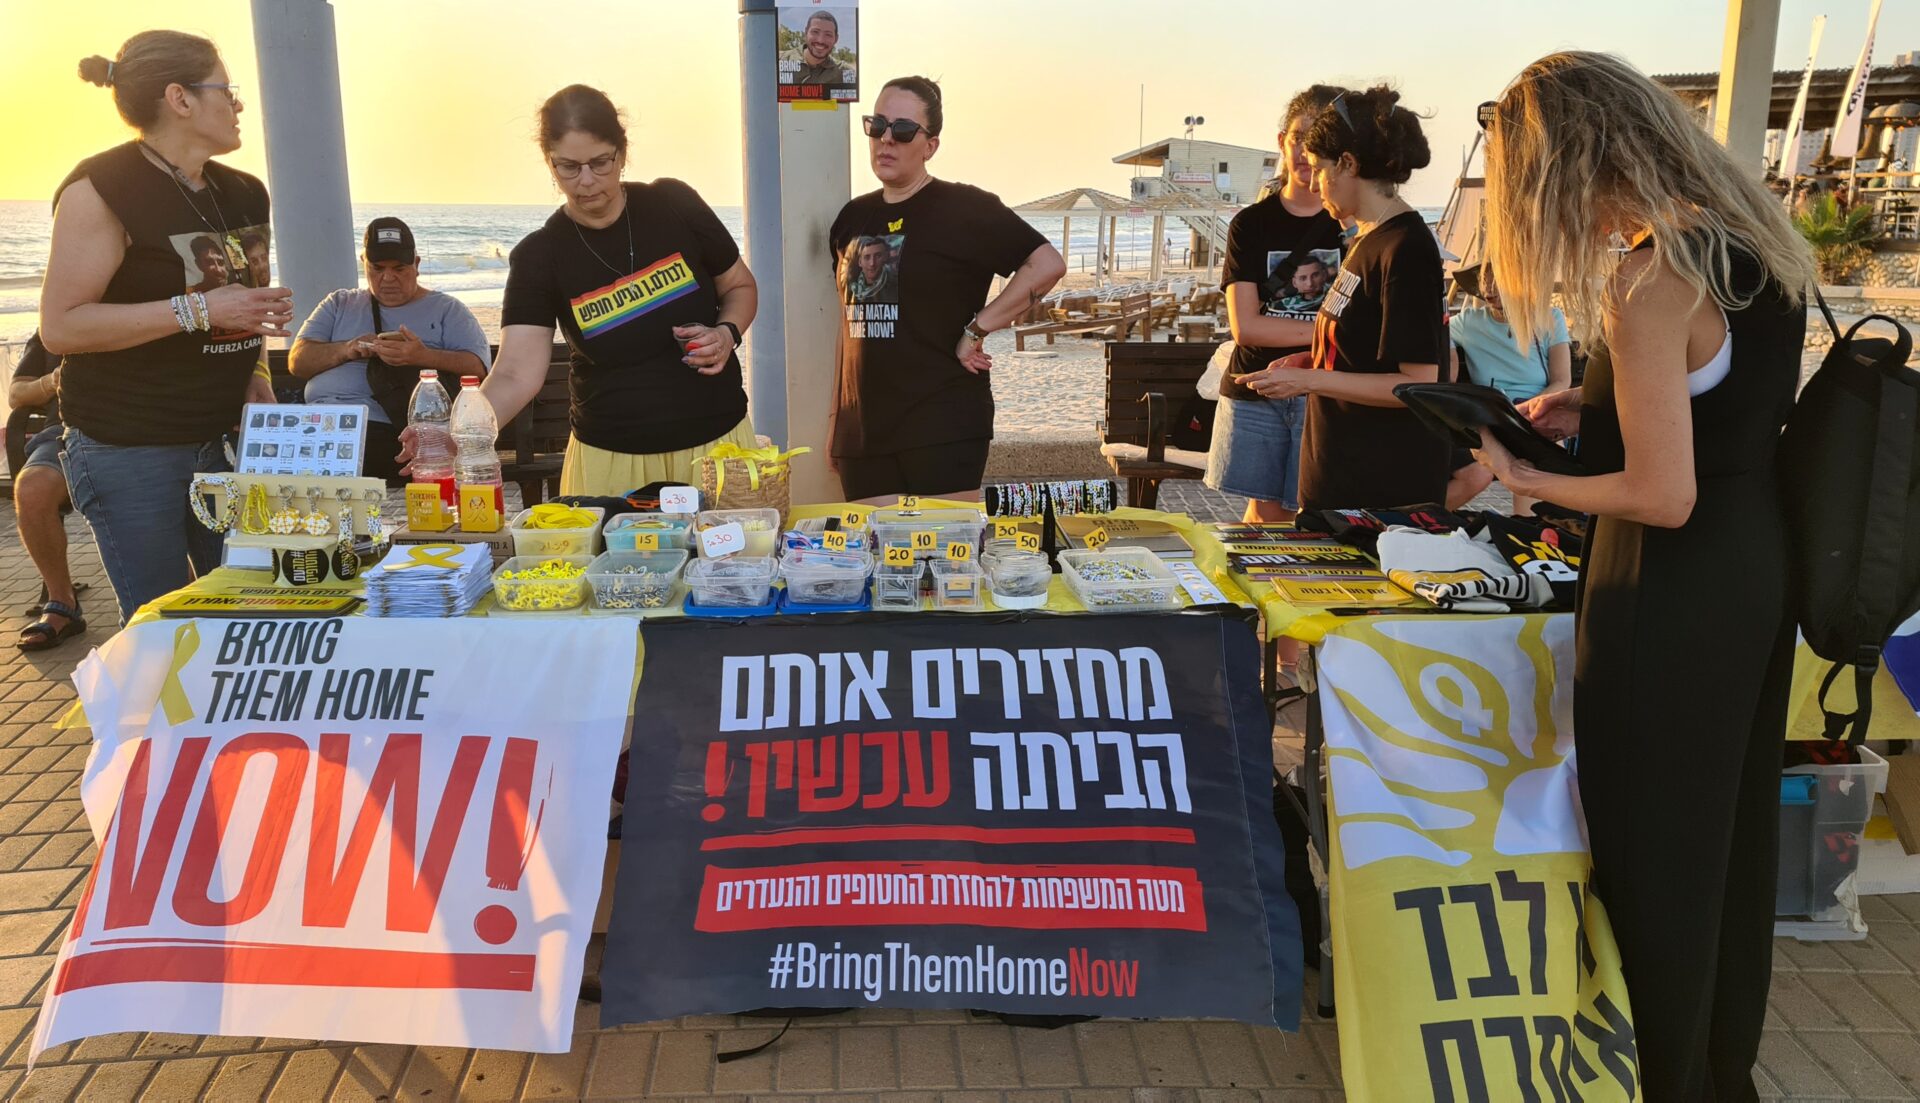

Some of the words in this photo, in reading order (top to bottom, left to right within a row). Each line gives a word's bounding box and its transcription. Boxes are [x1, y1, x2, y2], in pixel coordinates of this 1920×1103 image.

[578, 296, 614, 323] חופש
[865, 303, 899, 321] MATAN
[867, 321, 895, 339] NOW!
[202, 341, 242, 354] FUERZA
[902, 496, 917, 507] 25
[846, 513, 859, 524] 10
[639, 534, 653, 545] 15
[827, 536, 844, 547] 40
[916, 534, 931, 546] 10
[998, 525, 1017, 536] 30
[1088, 531, 1106, 547] 20
[951, 544, 967, 557] 10
[1021, 537, 1038, 548] 50
[889, 550, 909, 561] 20
[216, 618, 343, 667] BRING
[719, 650, 889, 733] אותם
[911, 646, 1174, 722] מחזירים
[205, 669, 309, 724] THEM
[314, 667, 435, 722] HOME
[700, 730, 951, 822] עכשיו!
[969, 731, 1193, 814] הביתה
[716, 875, 820, 912] והנעדרים
[825, 872, 924, 905] החטופים
[930, 873, 1015, 908] להחזרת
[1020, 877, 1134, 911] המשפחות
[1136, 878, 1186, 913] מטה
[768, 942, 1139, 1001] #BringThemHomeNow
